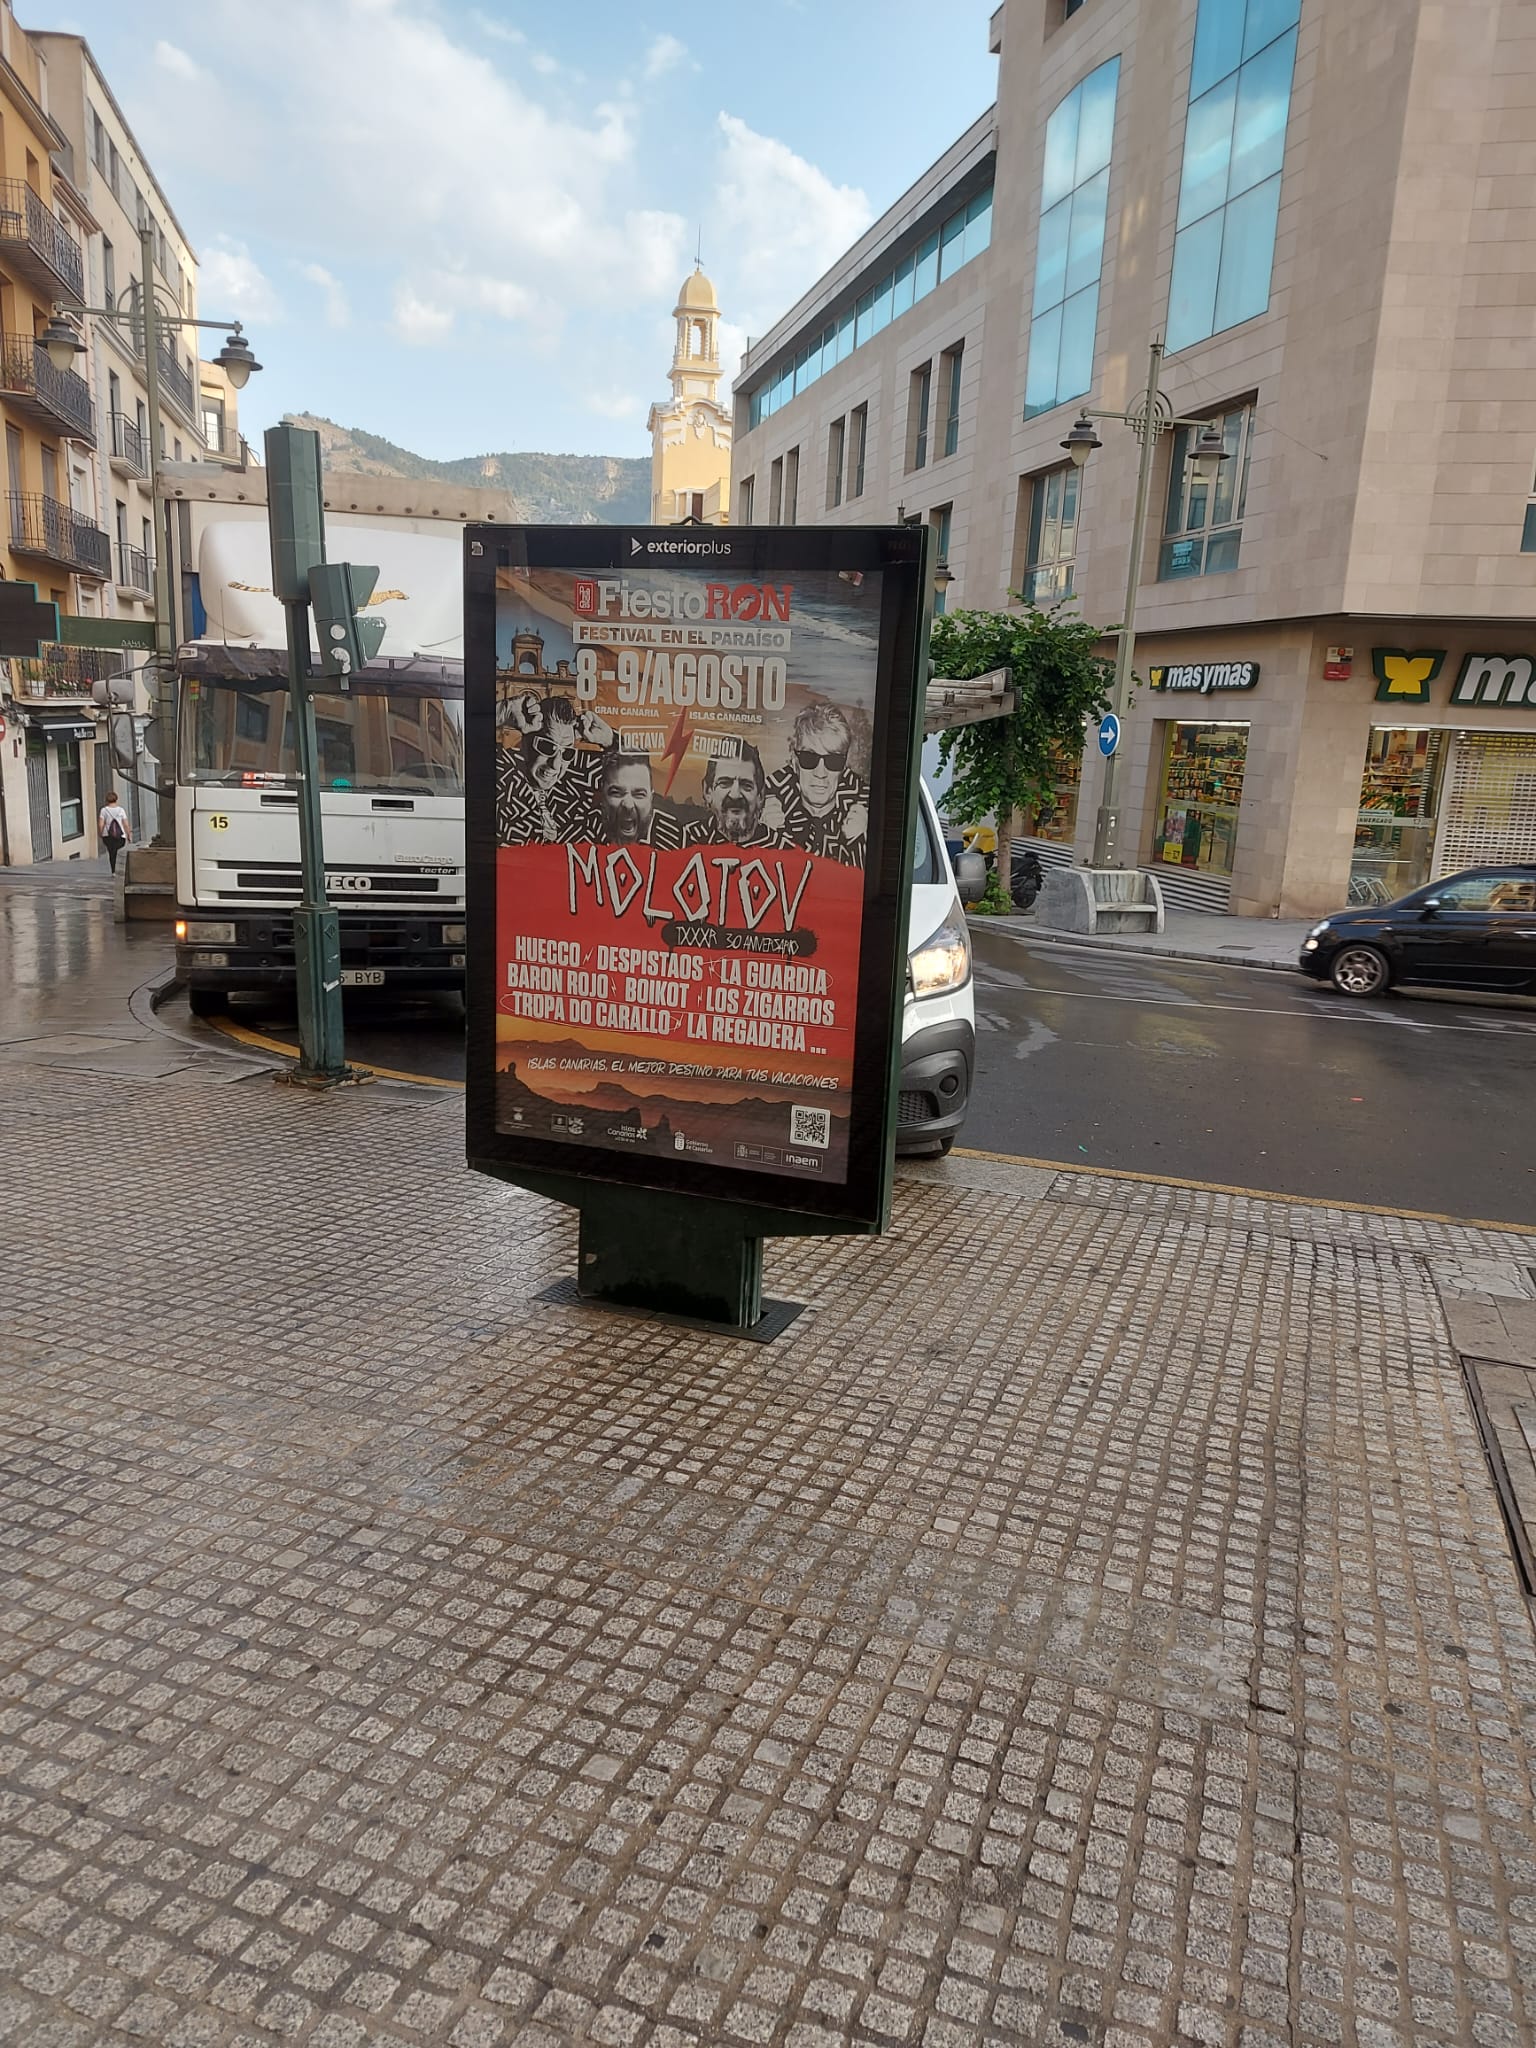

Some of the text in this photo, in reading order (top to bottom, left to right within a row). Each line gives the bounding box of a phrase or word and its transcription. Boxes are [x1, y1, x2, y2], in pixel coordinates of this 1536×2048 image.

[647, 539, 732, 557] exteriorplus
[597, 579, 794, 622] FiestoRON
[579, 626, 785, 648] FESTIVAL EN EL PARAÍSO
[1166, 662, 1252, 693] masymas
[1459, 656, 1536, 704] m
[594, 705, 660, 718] GRAN CANARIA
[689, 710, 763, 724] ISLAS CANARIAS
[623, 730, 737, 758] OCTAVA EDICIÓN
[210, 816, 229, 829] 15
[566, 842, 813, 932] MOLOTOV
[725, 932, 742, 950] 30
[355, 971, 382, 984] BYB
[515, 935, 828, 996] HUECCO DESPISTAOS LA GUARDIA
[507, 962, 836, 1026] BARON ROJO BOIKOT LOS ZIGARROS
[512, 990, 565, 1022] TROPA
[569, 998, 592, 1025] DO
[596, 1001, 671, 1036] CARALLO
[687, 1012, 708, 1040] LA
[711, 1015, 806, 1053] REGADERA
[527, 1057, 839, 1090] ISLAS CANARIAS, EL MEJOR DESTINO PARA TUS VACACIONES
[785, 1153, 818, 1167] inaem
